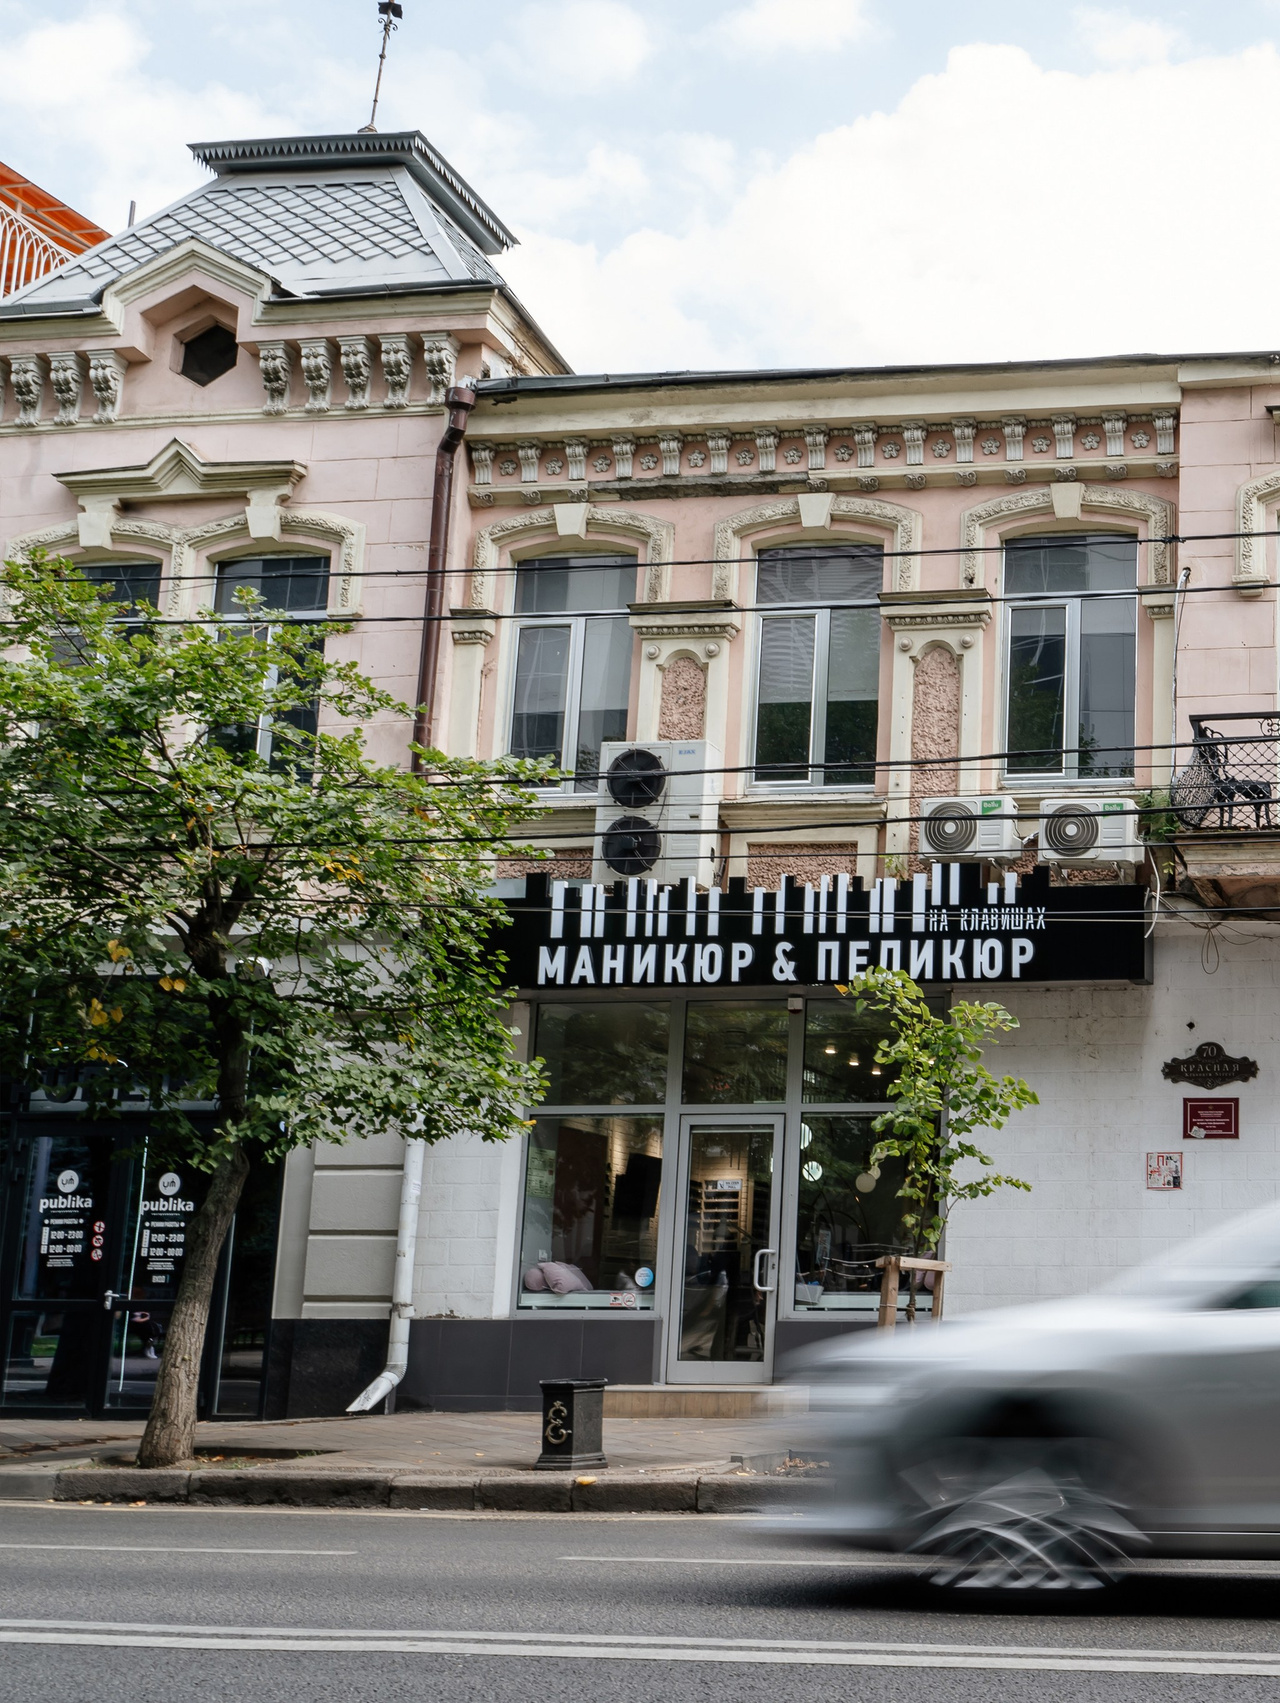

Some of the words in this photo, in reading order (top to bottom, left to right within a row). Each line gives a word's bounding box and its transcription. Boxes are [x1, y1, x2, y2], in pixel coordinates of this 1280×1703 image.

[929, 908, 948, 932] НА
[960, 906, 1046, 931] КЛАВИШАХ
[537, 942, 754, 985] МАНИКЮР
[772, 941, 798, 982] &
[1202, 1046, 1216, 1057] 70
[1180, 1064, 1239, 1072] КРАСНАЯ
[39, 1195, 93, 1213] publika
[140, 1198, 194, 1216] publika
